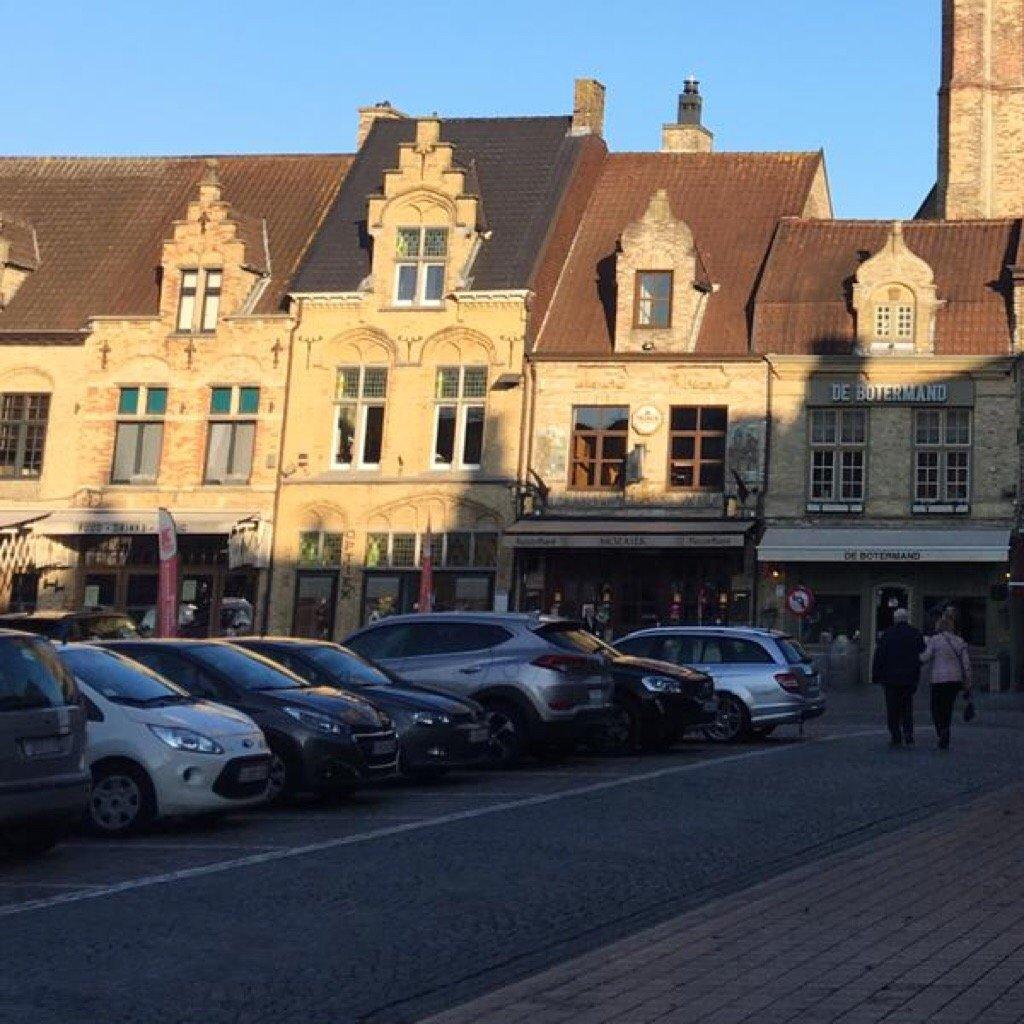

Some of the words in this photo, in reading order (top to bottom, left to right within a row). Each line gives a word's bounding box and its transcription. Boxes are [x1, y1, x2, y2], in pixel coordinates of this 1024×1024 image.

[832, 383, 851, 400] DE
[856, 383, 947, 401] BOTERMAND
[859, 552, 921, 560] BOTERMAND
